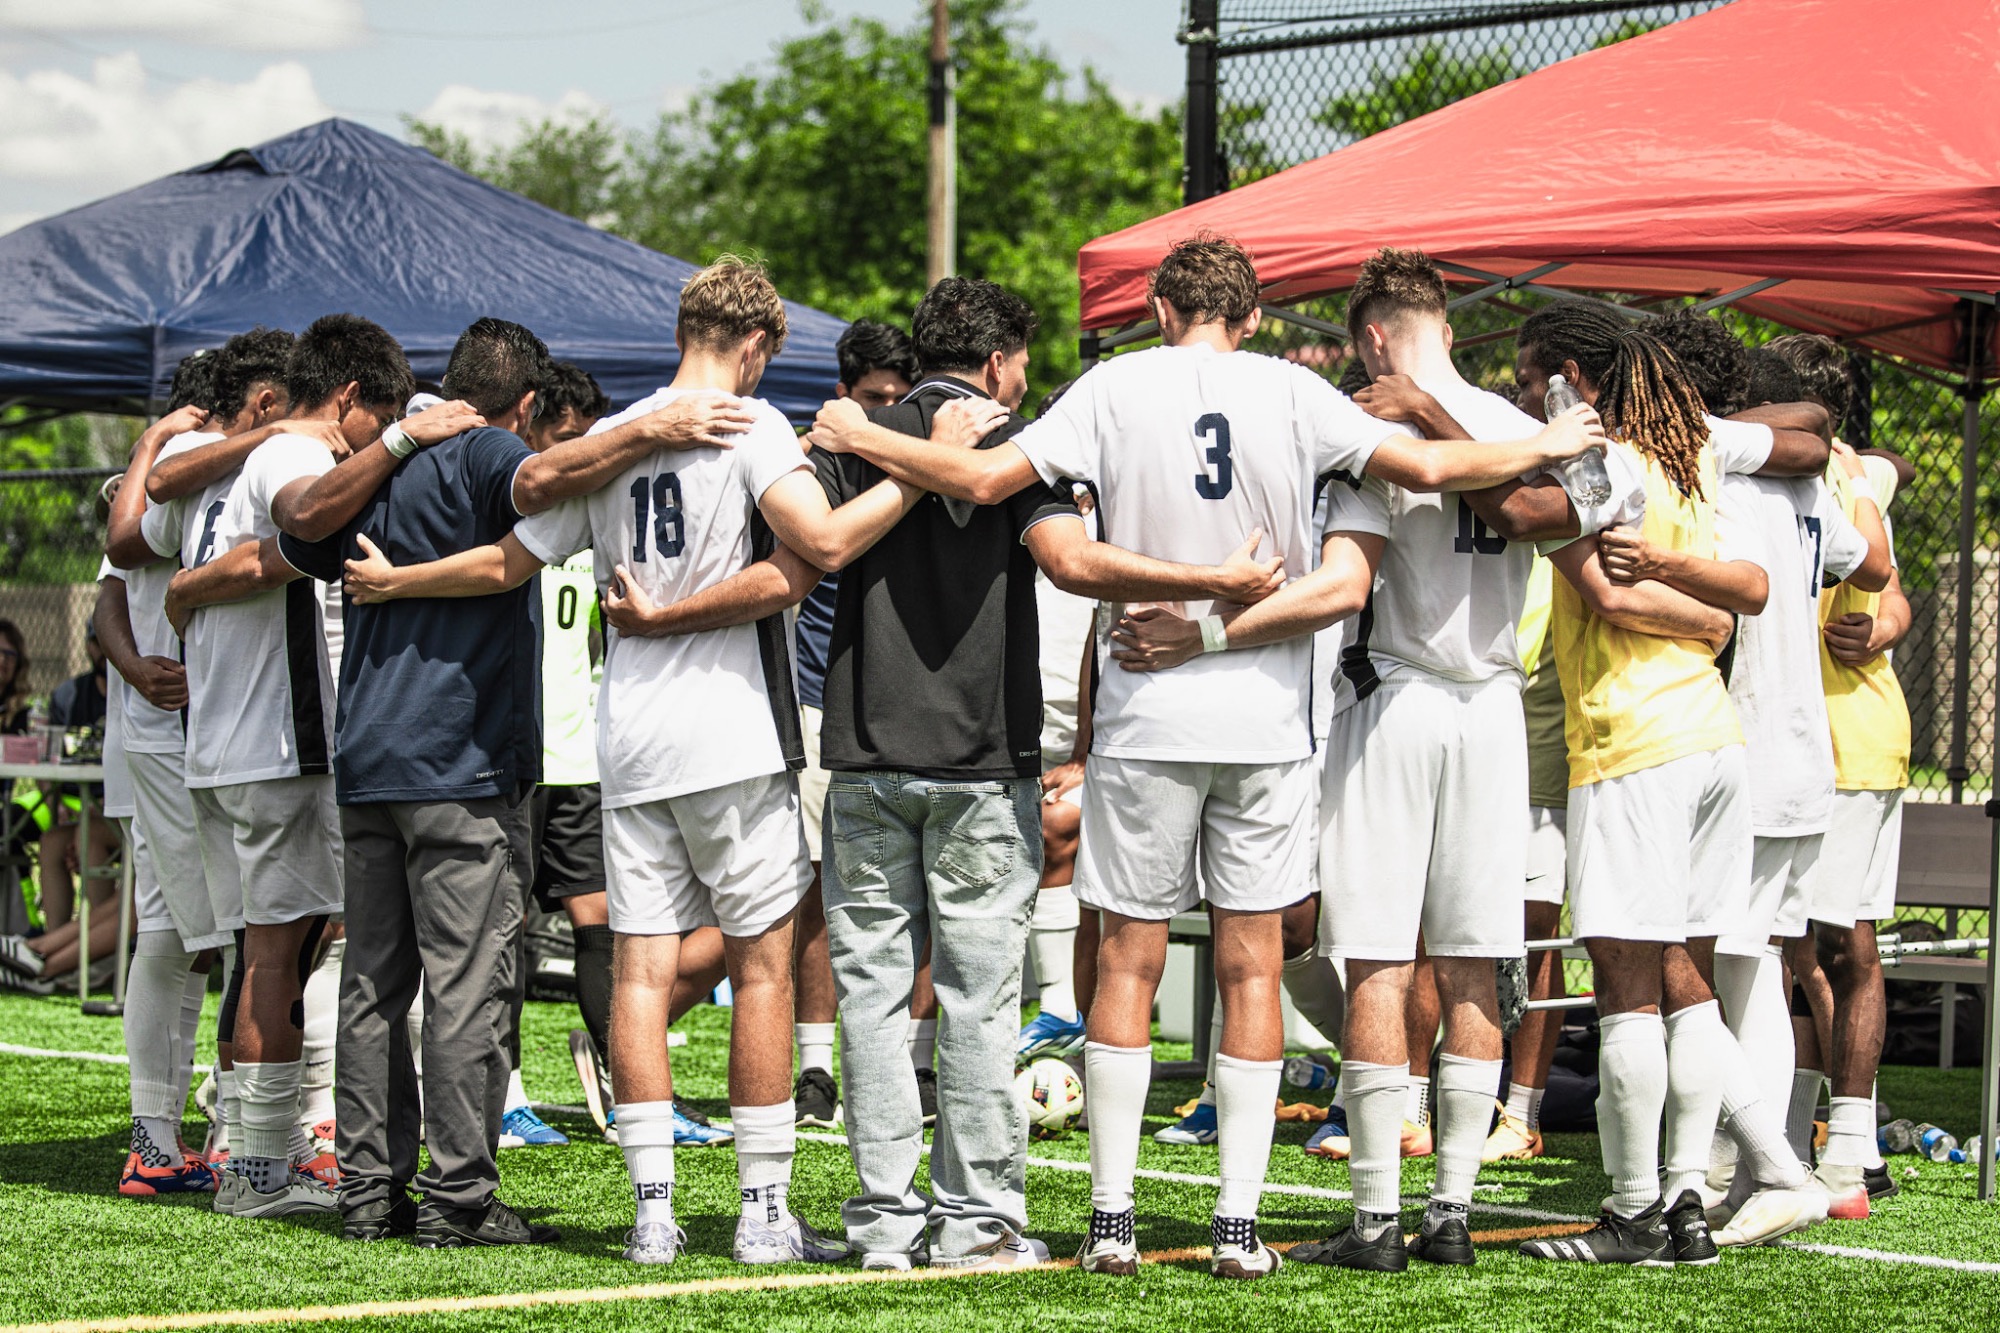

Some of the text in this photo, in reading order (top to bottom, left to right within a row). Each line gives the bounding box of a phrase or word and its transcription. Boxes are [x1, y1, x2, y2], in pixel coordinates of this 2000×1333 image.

[1195, 412, 1232, 500] 3
[630, 471, 686, 563] 18
[557, 585, 578, 630] 0
[741, 1187, 756, 1202] S
